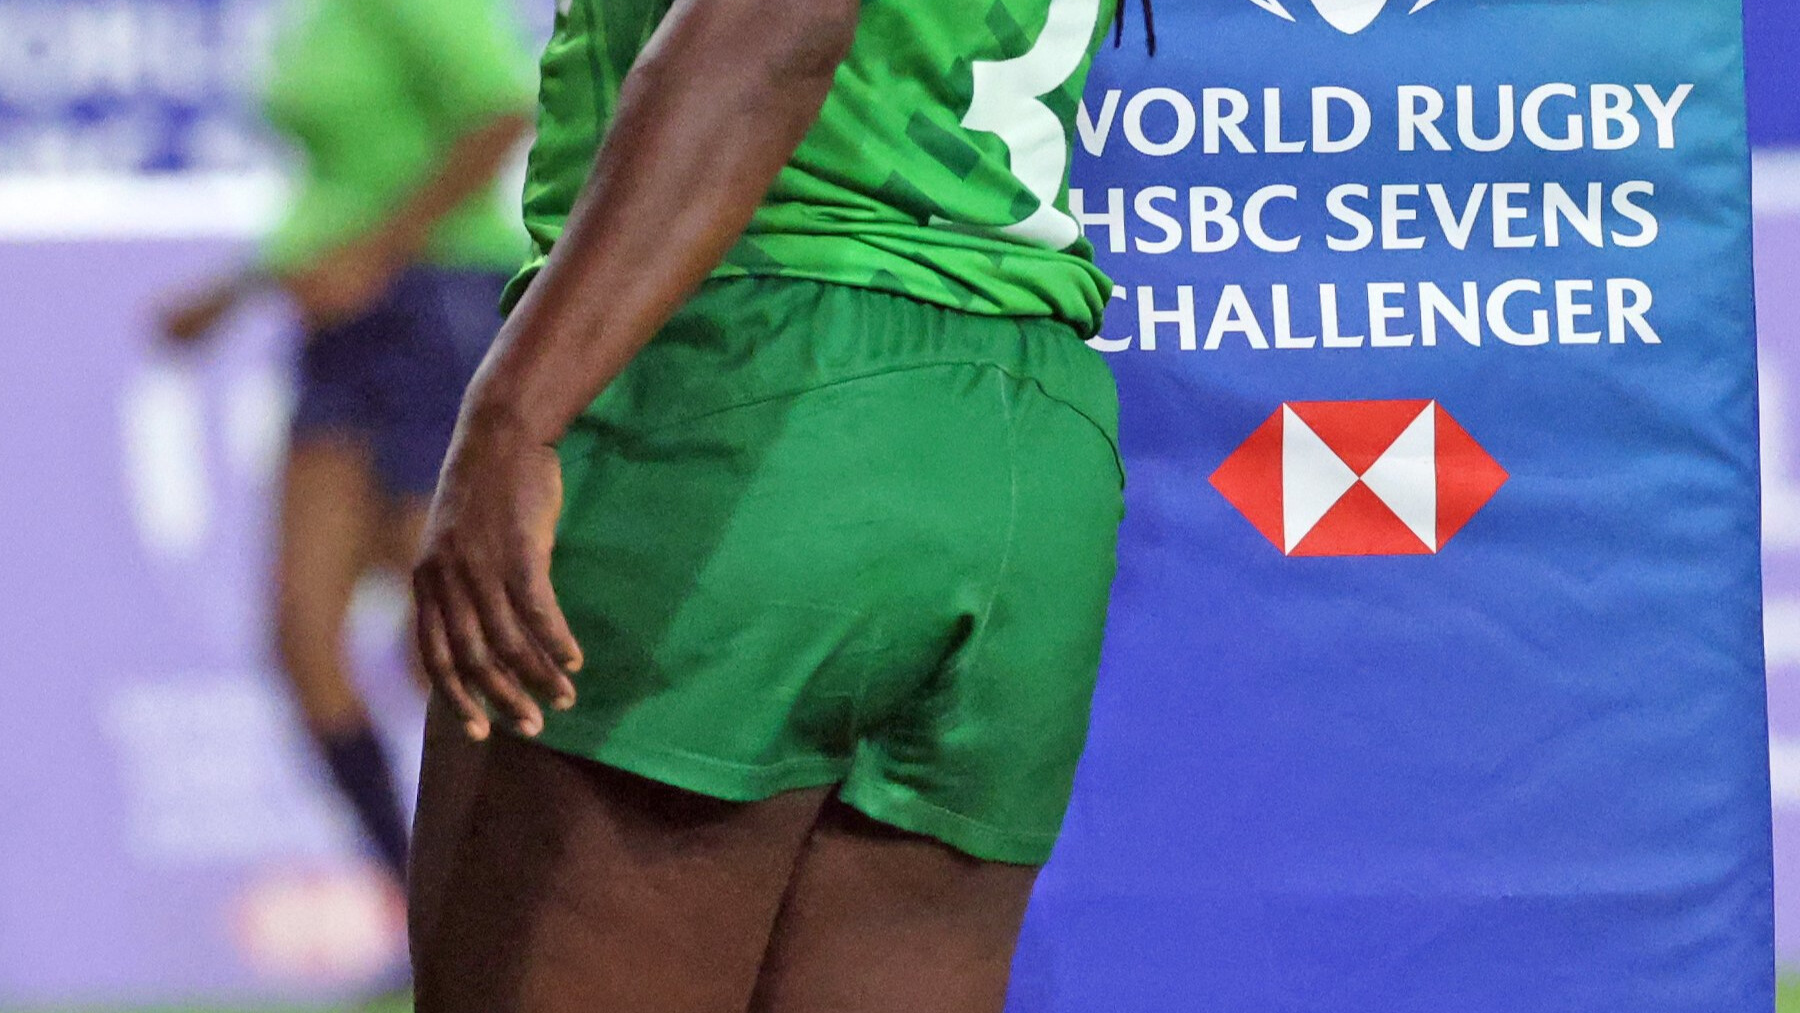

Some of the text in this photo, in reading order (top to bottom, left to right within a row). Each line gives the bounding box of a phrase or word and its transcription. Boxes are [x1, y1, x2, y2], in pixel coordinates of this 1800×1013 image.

[1397, 83, 1695, 152] RUGBY
[1068, 180, 1660, 254] HSBC SEVENS
